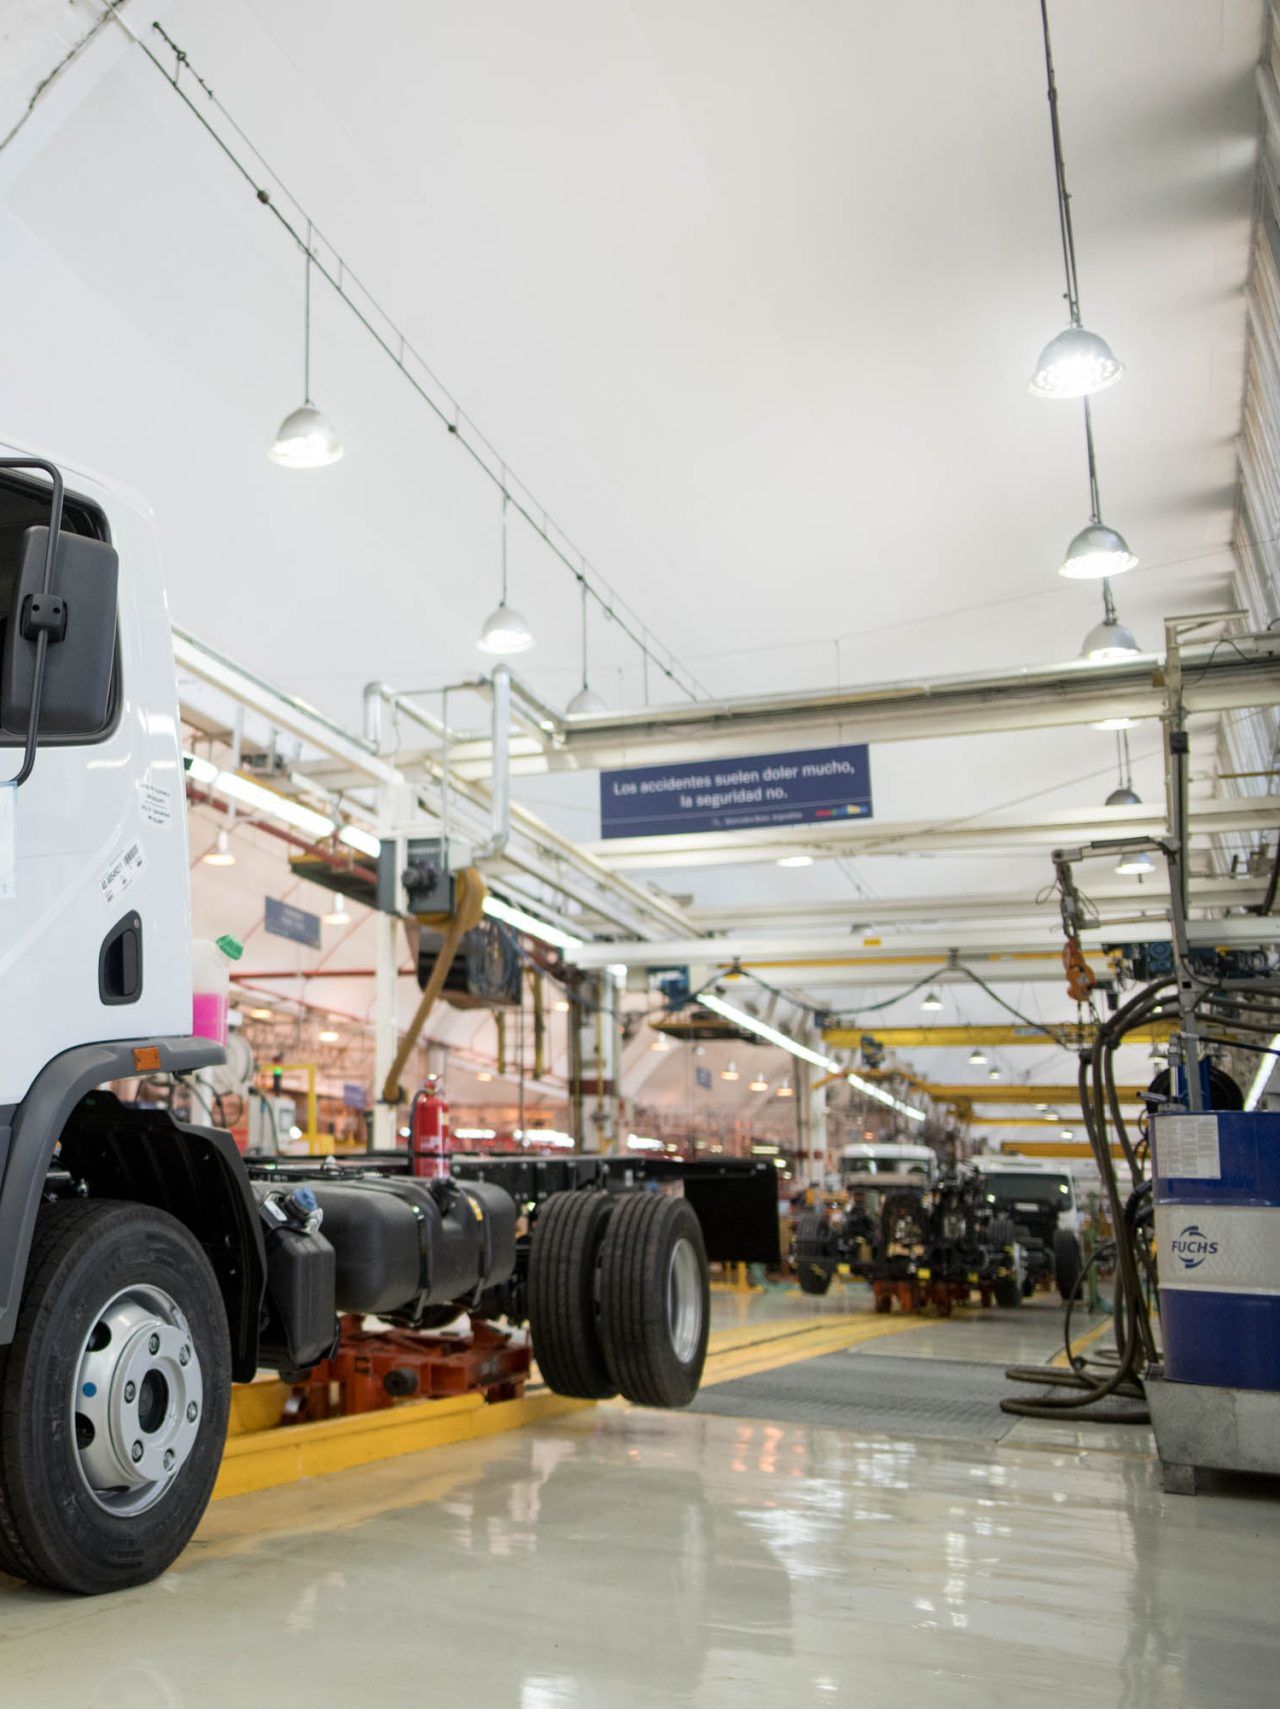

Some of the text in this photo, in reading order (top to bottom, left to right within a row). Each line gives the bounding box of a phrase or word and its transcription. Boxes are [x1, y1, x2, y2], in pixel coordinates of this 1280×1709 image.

[613, 760, 855, 796] Los accidentes suelen doler mucho,
[680, 786, 788, 809] la seguridad no.
[1171, 1240, 1219, 1255] FUCHS
